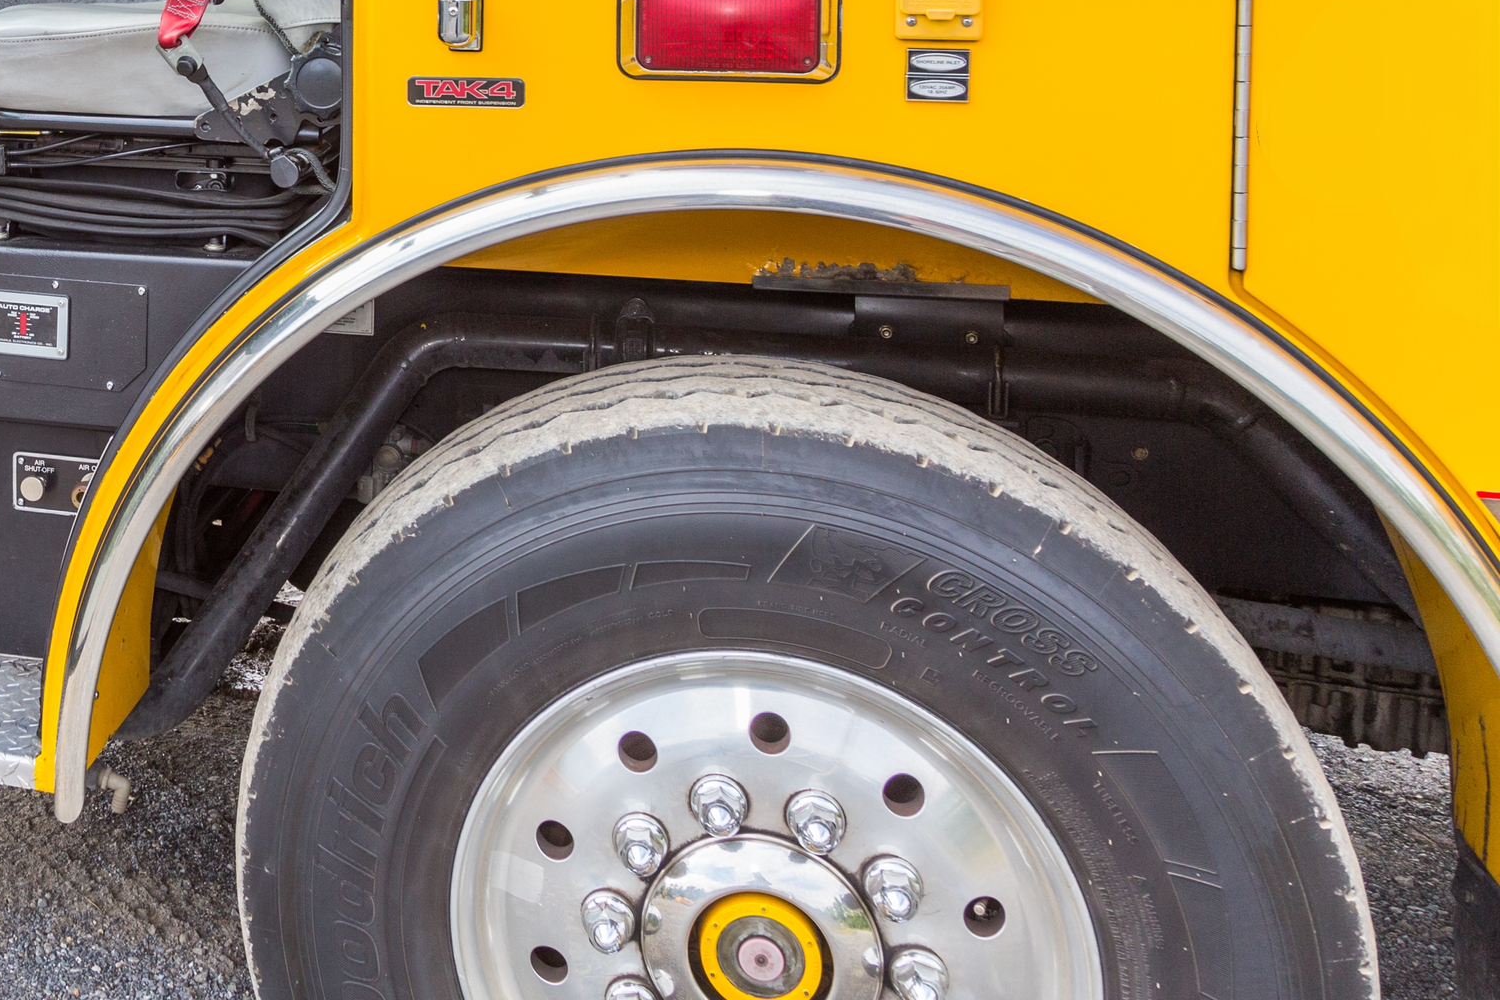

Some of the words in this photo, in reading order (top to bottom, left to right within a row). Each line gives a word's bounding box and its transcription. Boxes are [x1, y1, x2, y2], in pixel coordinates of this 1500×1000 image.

[415, 79, 516, 99] TAK-4
[24, 465, 55, 474] SHUT-OFF
[879, 621, 927, 649] RADIAL
[927, 570, 1098, 676] CROSS
[890, 597, 1098, 738] CONTROL
[972, 669, 1061, 743] REGROOVABLE
